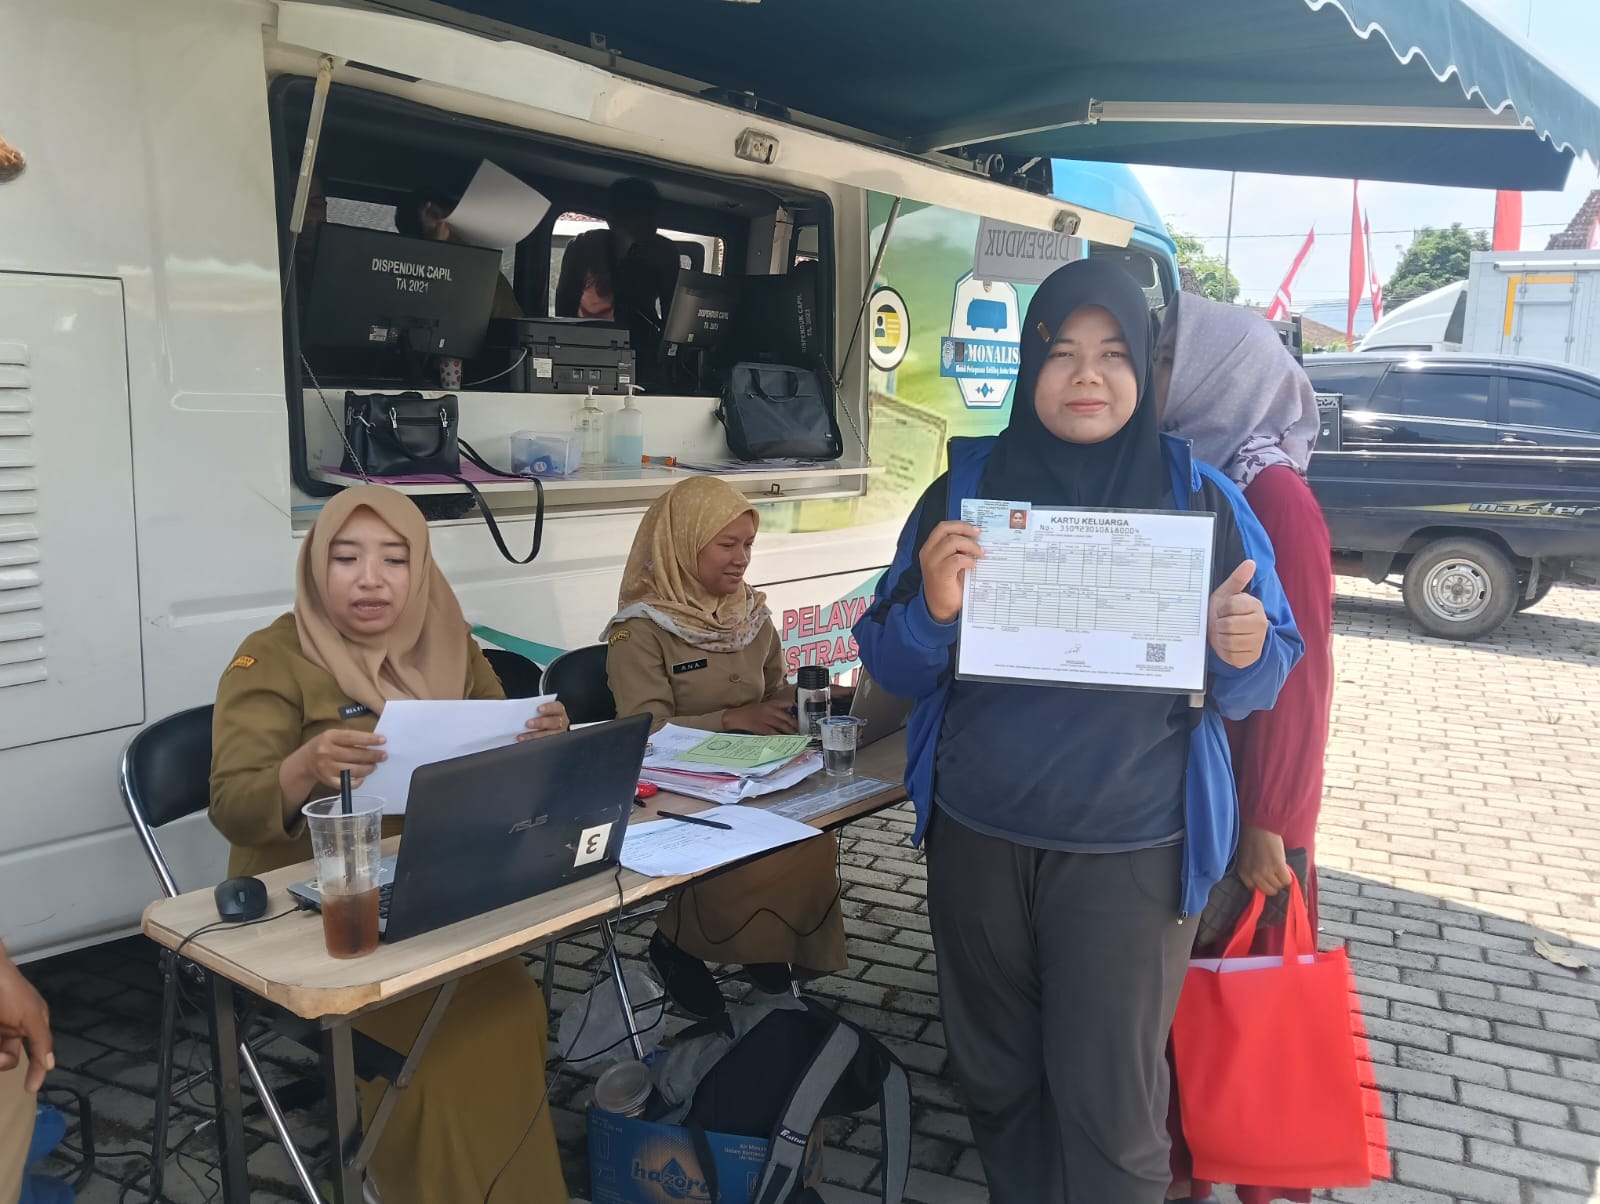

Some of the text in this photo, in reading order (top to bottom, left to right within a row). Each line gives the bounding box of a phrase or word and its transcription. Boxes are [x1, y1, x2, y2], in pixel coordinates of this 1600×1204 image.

[371, 258, 453, 281] DISPENDUK CAPIL
[396, 277, 429, 293] TA 2021
[1469, 502, 1598, 516] master
[1051, 516, 1129, 526] KARTU KELUARGA
[782, 594, 875, 642] PELAYA
[781, 635, 860, 677] STRAS
[681, 662, 700, 671] ANA
[508, 814, 548, 834] ASUS
